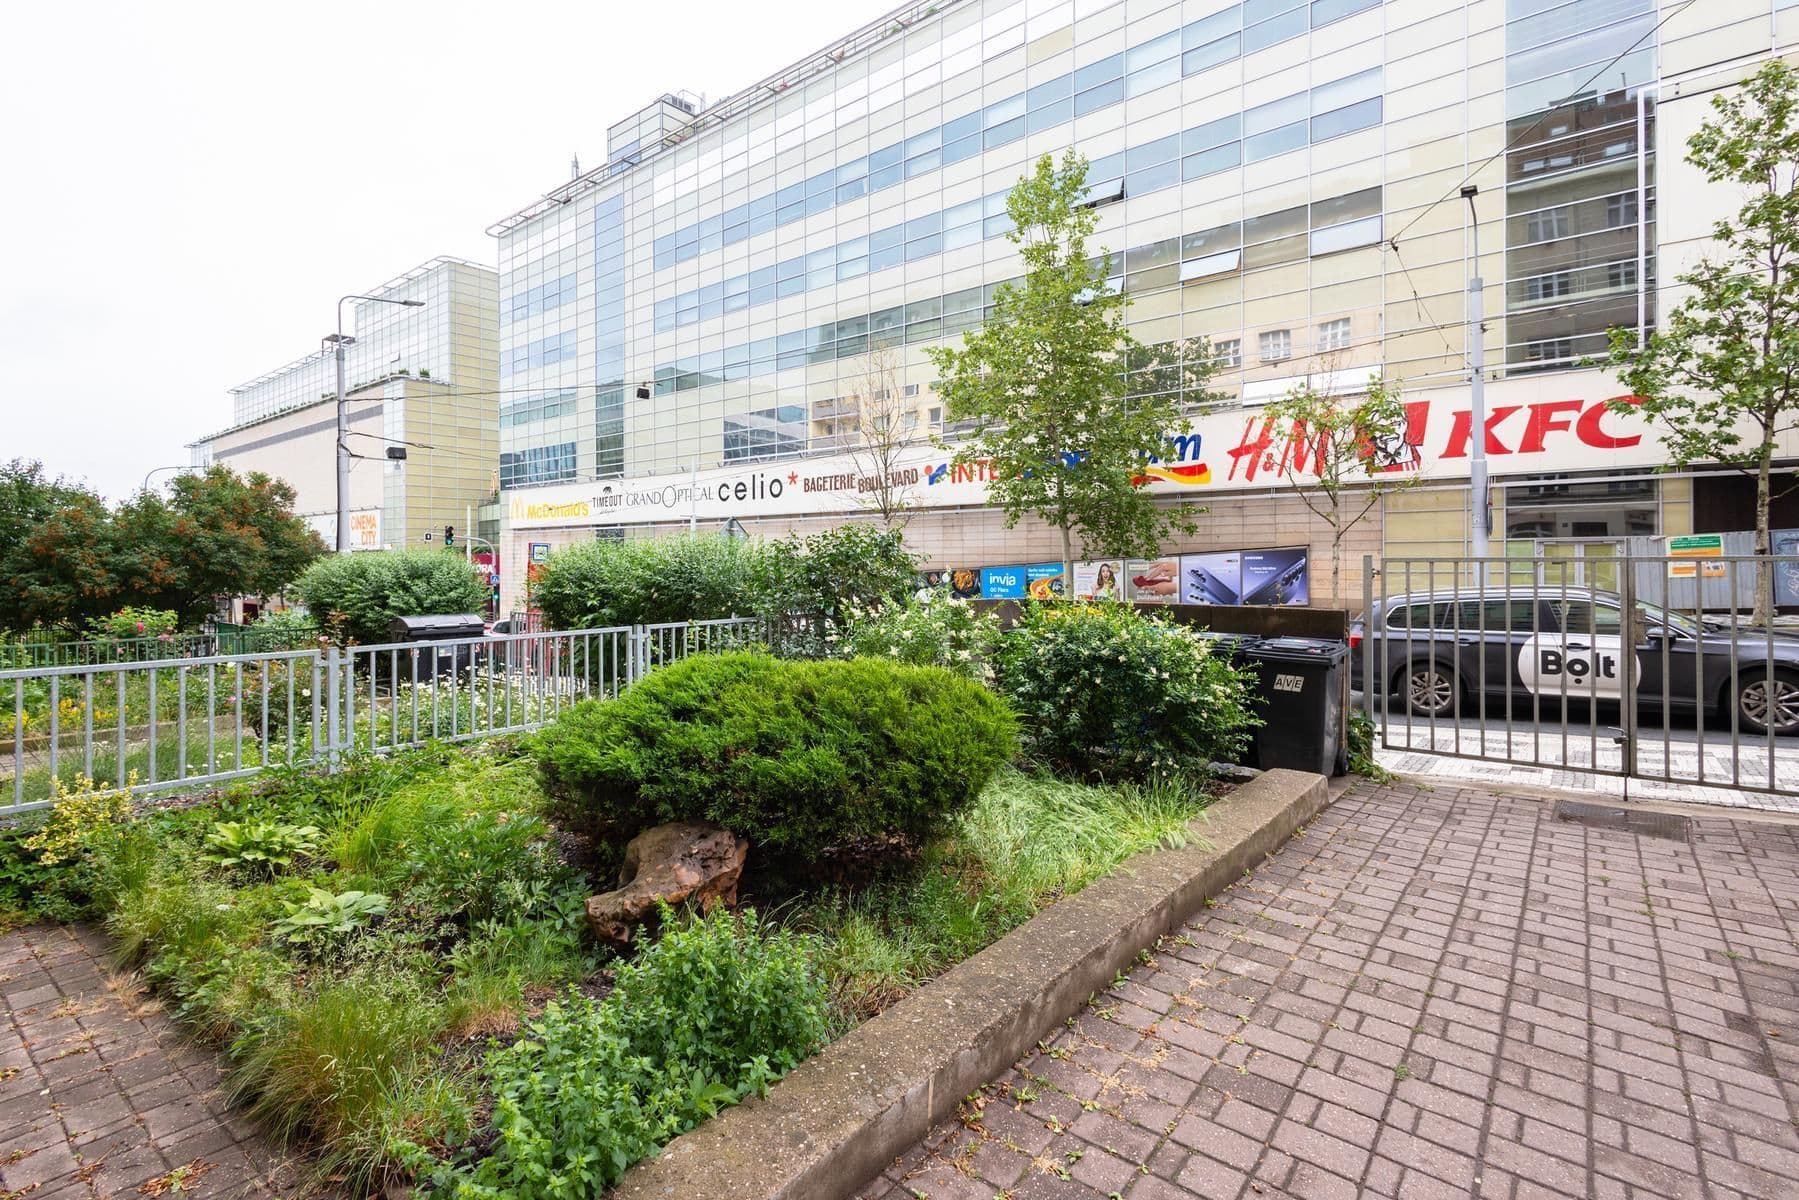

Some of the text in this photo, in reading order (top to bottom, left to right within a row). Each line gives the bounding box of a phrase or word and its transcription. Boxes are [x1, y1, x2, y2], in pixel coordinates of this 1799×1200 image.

[1438, 394, 1654, 460] KFC
[1226, 415, 1331, 482] H&M
[803, 468, 919, 494] BAGETERIE BOULEVARD
[527, 502, 590, 520] McDonald's
[350, 514, 377, 531] CINEMA
[361, 530, 377, 546] CITY
[989, 572, 1016, 587] invia
[1541, 649, 1616, 683] Bolt
[1275, 678, 1302, 689] AVE
